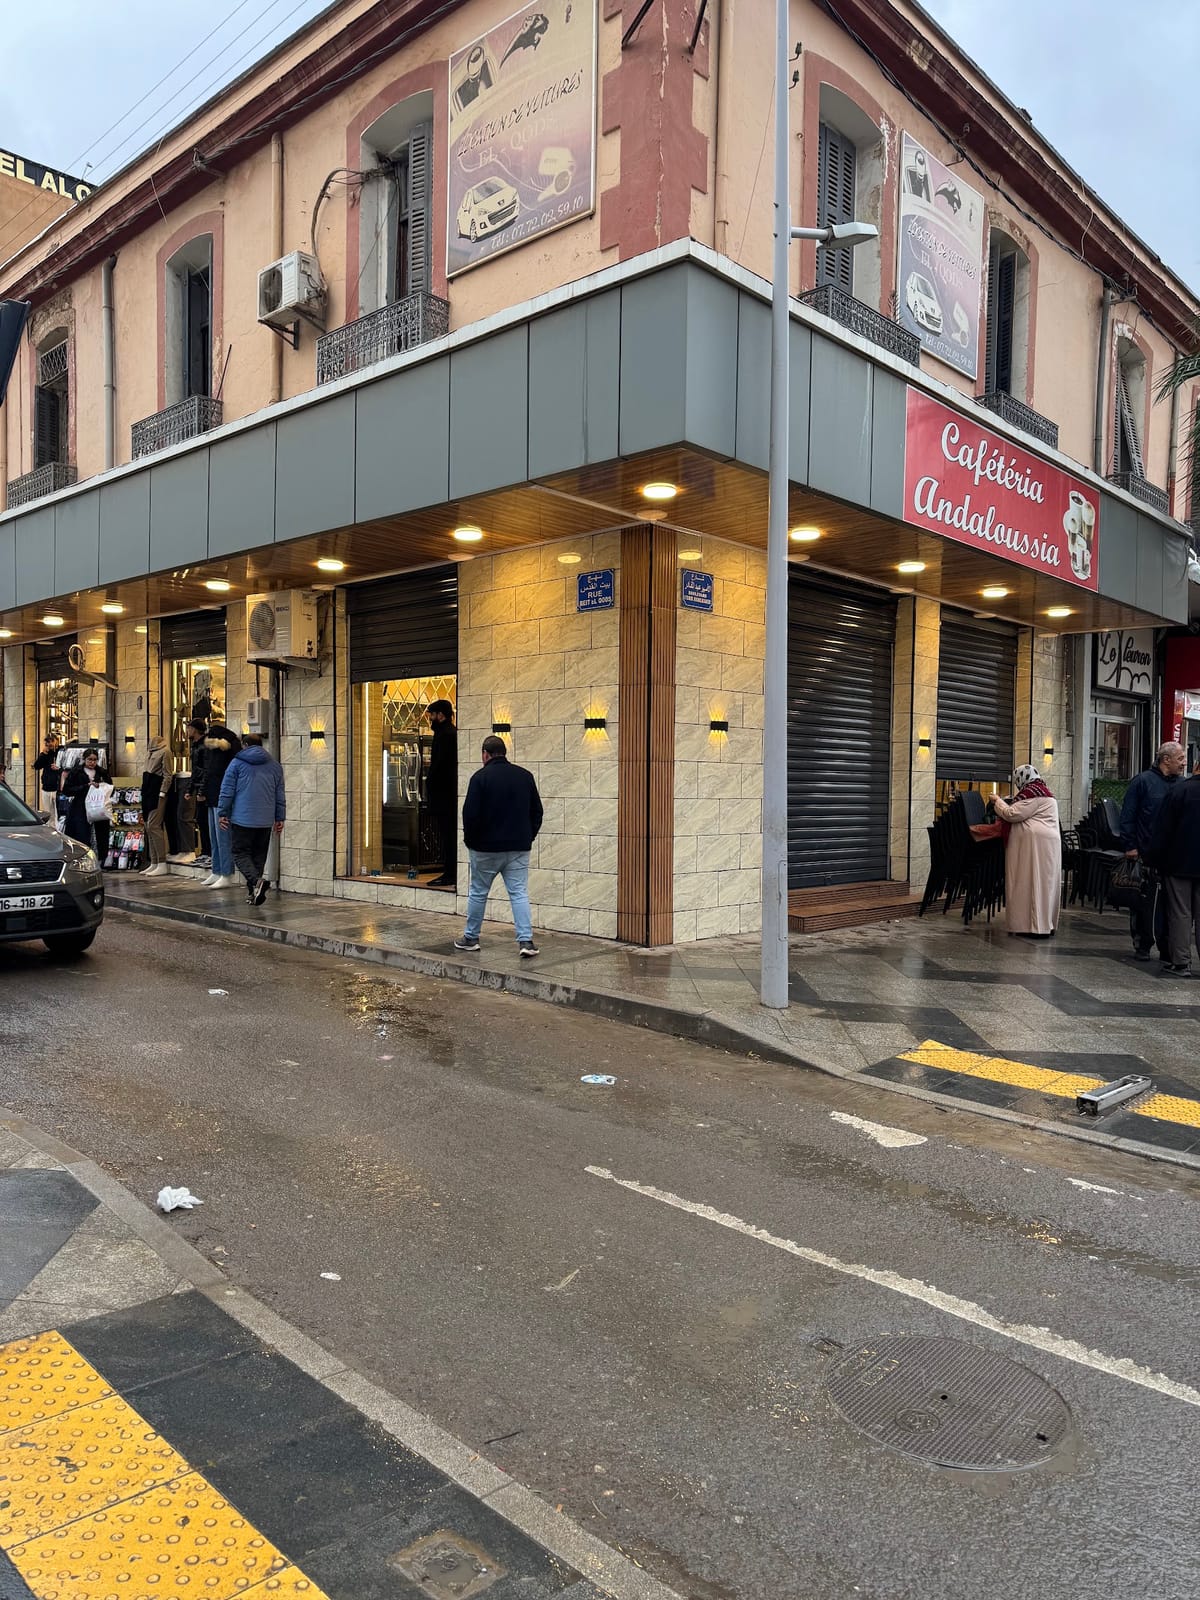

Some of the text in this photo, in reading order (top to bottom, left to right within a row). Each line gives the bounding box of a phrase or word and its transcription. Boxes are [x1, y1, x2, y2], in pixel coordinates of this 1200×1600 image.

[941, 422, 1045, 504] Cafétéria
[914, 476, 1061, 567] Andaloussia
[587, 590, 603, 599] RUE
